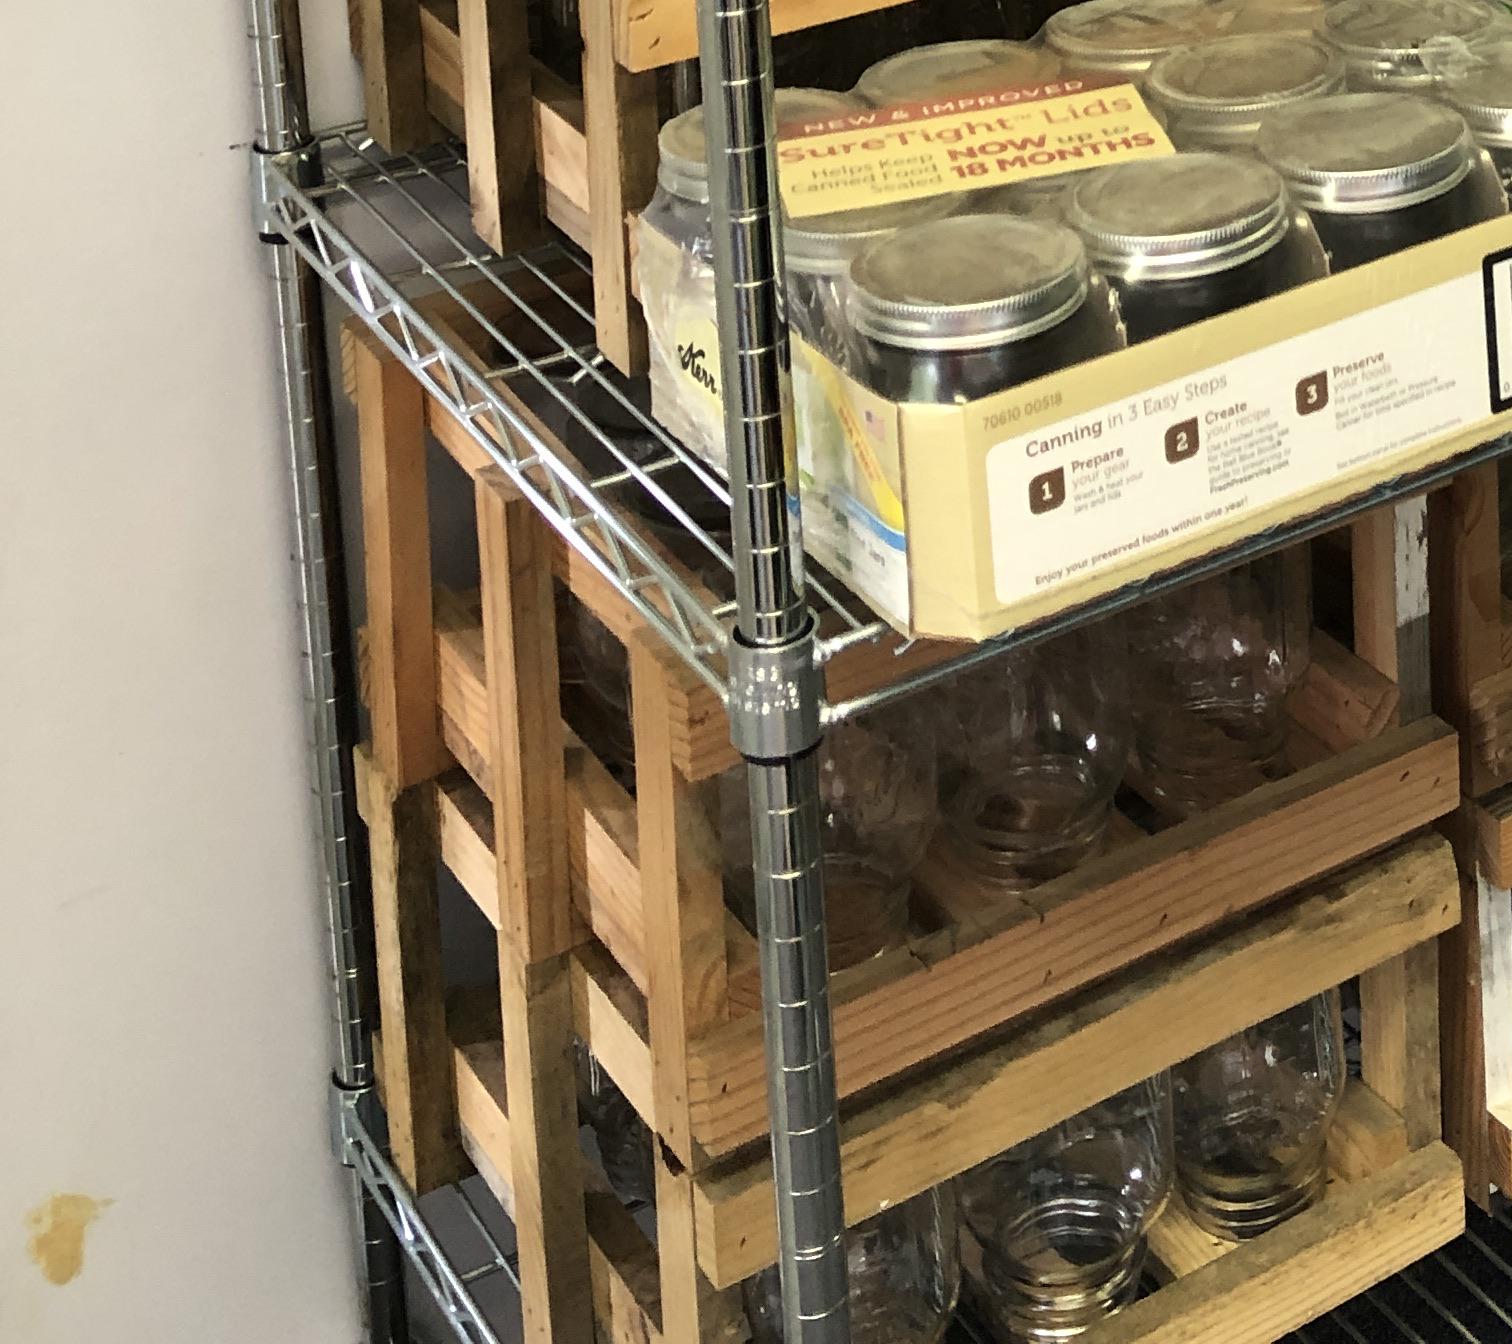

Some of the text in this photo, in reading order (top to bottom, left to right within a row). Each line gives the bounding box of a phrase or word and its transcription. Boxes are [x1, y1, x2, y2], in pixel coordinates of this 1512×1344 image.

[804, 79, 1084, 134] NEW & IMPROVED
[1040, 97, 1133, 125] Lids
[947, 125, 1130, 163] NOW up to
[950, 131, 1156, 179] 18 MONTHS
[791, 163, 939, 194] Canned Food
[811, 153, 934, 180] Helps Keep
[676, 340, 718, 395] Kerr
[1333, 352, 1385, 378] Preserve
[1305, 383, 1318, 405] 3
[1503, 382, 1511, 394] 0
[982, 391, 1064, 432] 70610 00518
[1025, 374, 1228, 459] Canning in 3 Easy Steps
[1205, 402, 1247, 424] Create
[1176, 431, 1189, 453] 2
[1071, 447, 1124, 474] Prepare
[1041, 480, 1054, 501] 1
[1034, 495, 1249, 587] Enjoy your preserved foods within one year!
